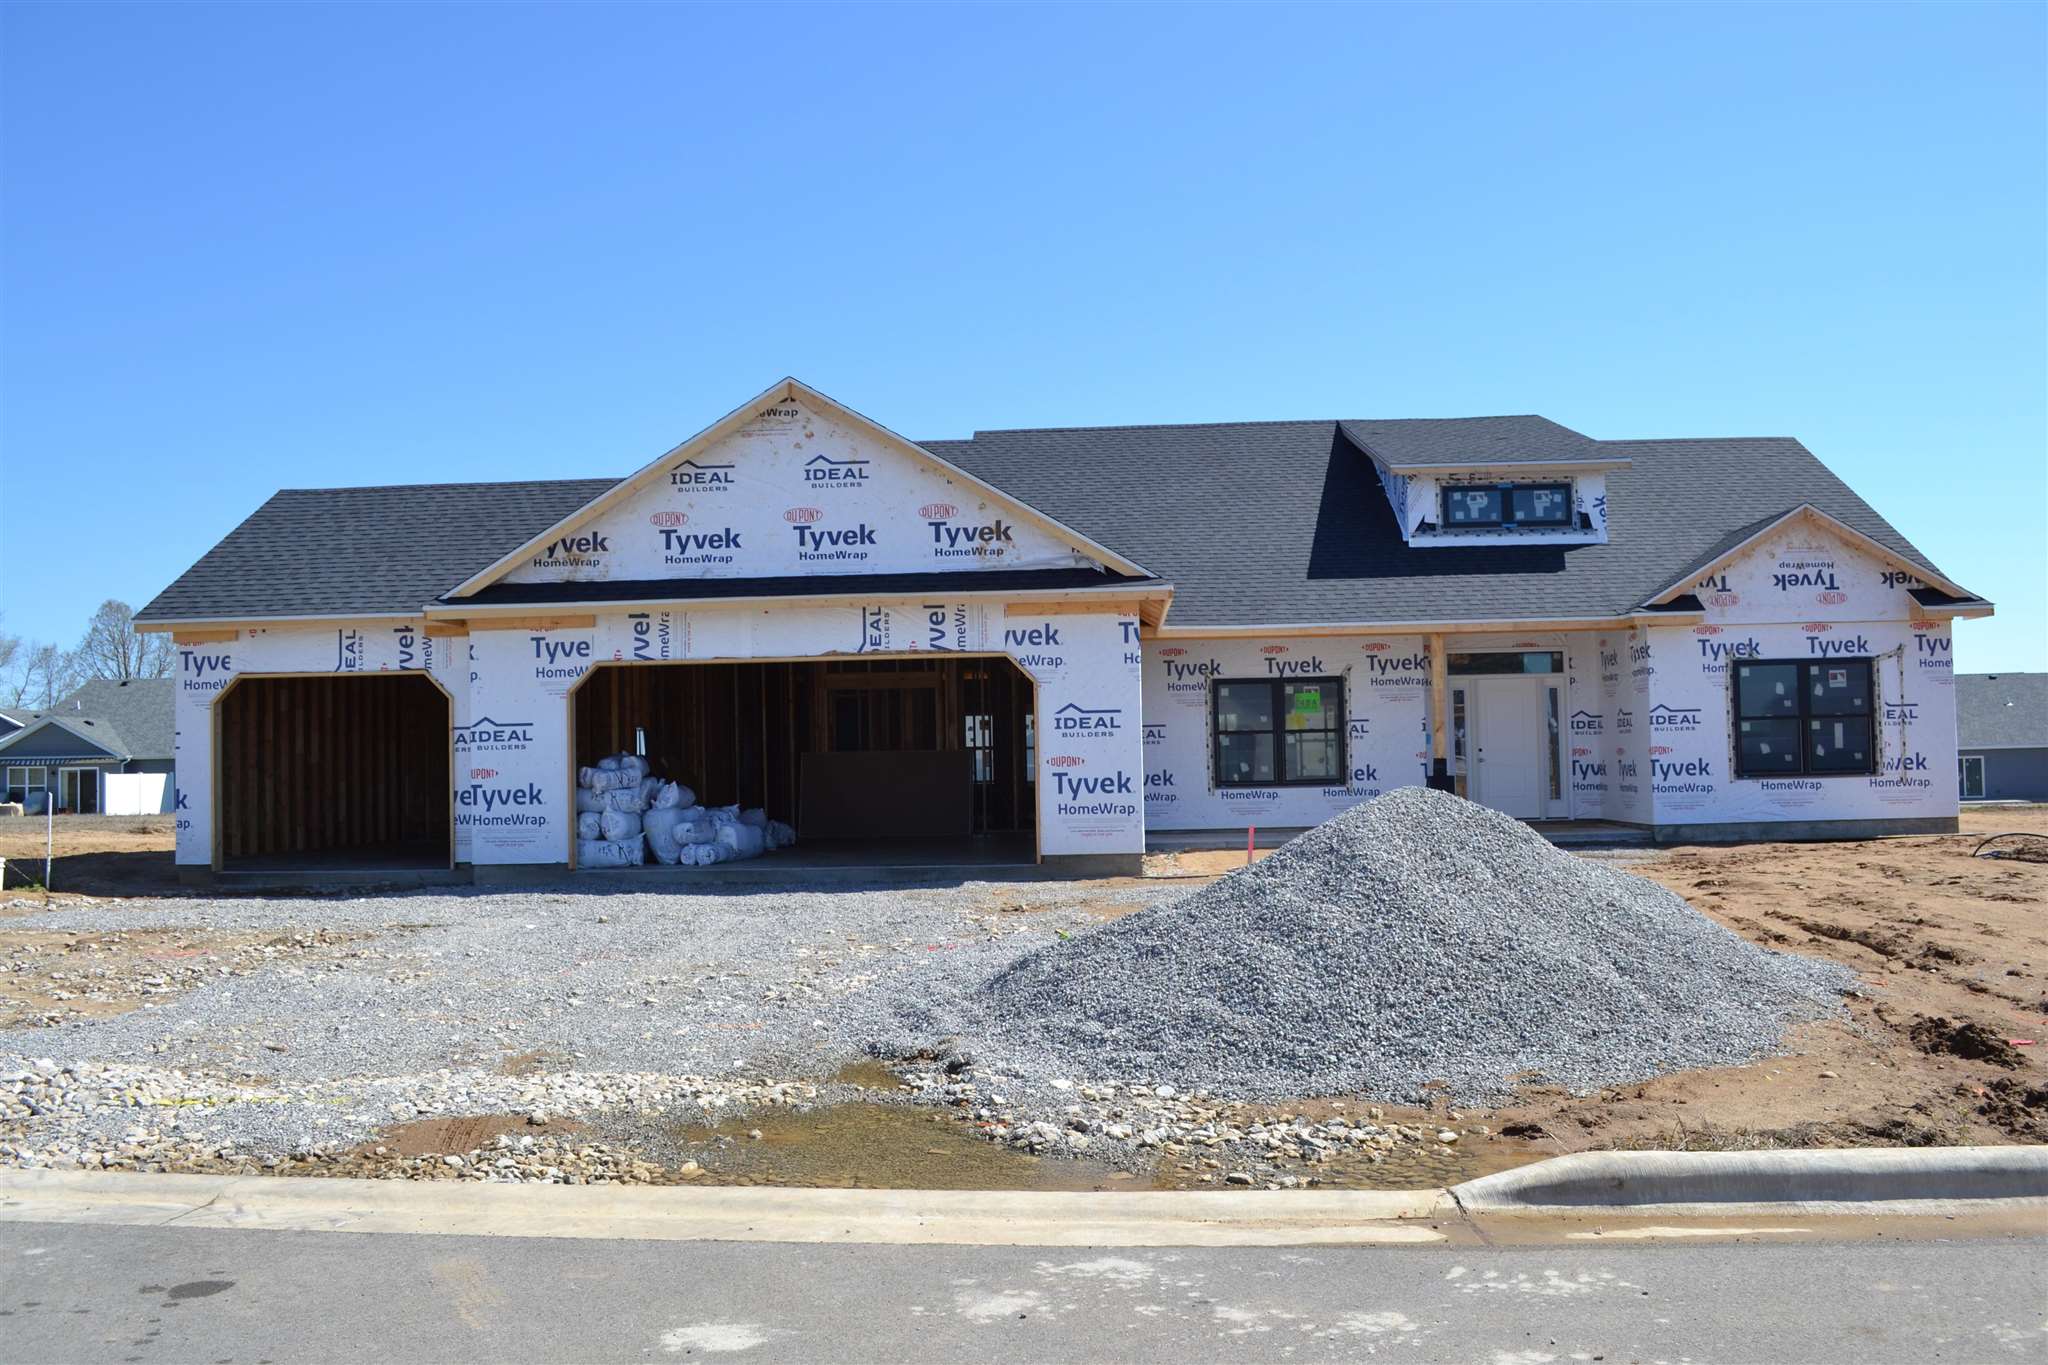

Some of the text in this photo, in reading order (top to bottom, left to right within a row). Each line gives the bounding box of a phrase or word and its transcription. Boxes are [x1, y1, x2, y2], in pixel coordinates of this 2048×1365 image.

[671, 472, 735, 485] IDEAL
[804, 467, 870, 481] IDEAL
[811, 481, 862, 489] BUILDERS
[793, 523, 877, 551] Tyvek
[928, 519, 1012, 548] Tyvek
[659, 527, 742, 555] Tyvek
[665, 554, 733, 564] HomeWrap
[799, 550, 868, 561] HomeWrap
[934, 547, 1004, 558] HomeWrap
[534, 557, 600, 568] HomeWrap
[1772, 569, 1839, 591] Tyvek
[1697, 637, 1761, 661] Tyvek
[1806, 635, 1869, 657] Tyvek
[1163, 659, 1222, 681] Tyvek
[1264, 656, 1323, 678] Tyvek
[1366, 653, 1424, 675] Tyvek
[1920, 658, 1953, 668] Home
[1054, 716, 1121, 730] IDEAL
[1649, 714, 1701, 725] IDEAL
[470, 730, 533, 743] IDEAL
[1050, 756, 1081, 767] DUPONT
[1650, 757, 1710, 782] Tyvek
[1052, 771, 1132, 801] Tyvek
[1652, 783, 1713, 794] HomeWrap
[1761, 780, 1822, 791] HomeWrap
[471, 782, 543, 812] Tyvek
[1221, 790, 1279, 801] HomeWrap
[1058, 803, 1136, 817] HomeWrap
[473, 814, 546, 827] HomeWrap
